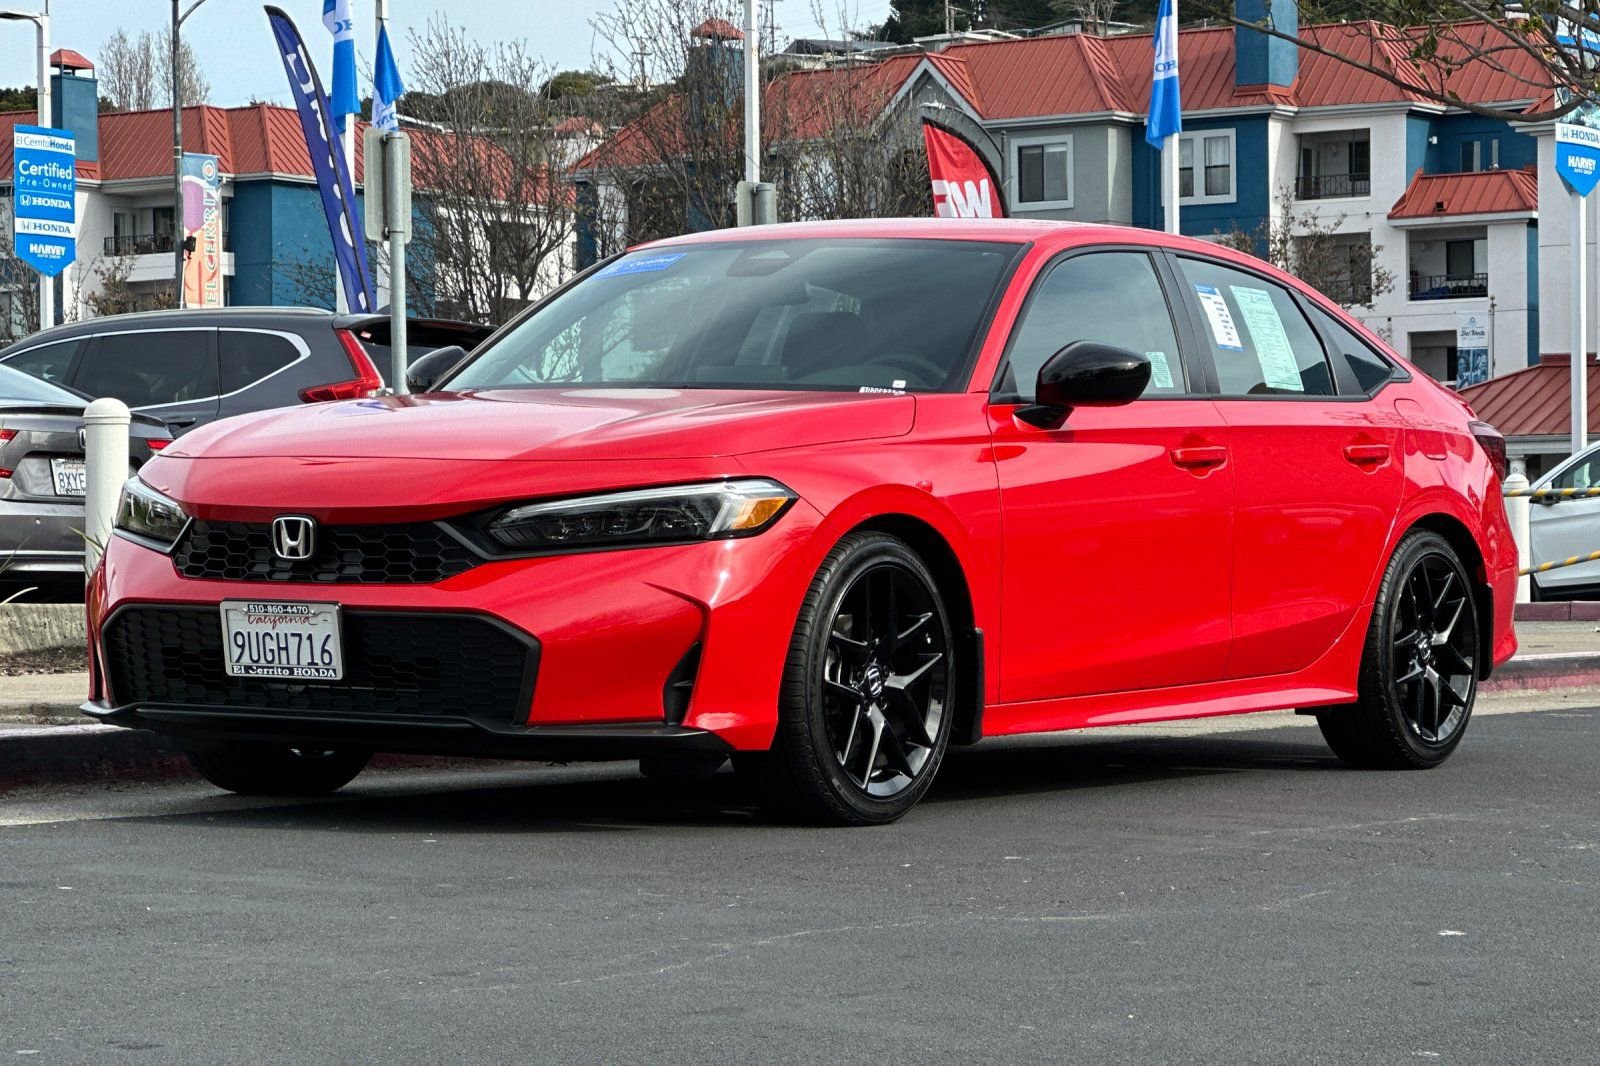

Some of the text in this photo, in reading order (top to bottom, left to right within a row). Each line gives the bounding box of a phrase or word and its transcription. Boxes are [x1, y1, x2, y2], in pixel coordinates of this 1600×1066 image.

[1571, 129, 1600, 144] HONDA
[18, 159, 73, 180] Certified
[1568, 155, 1596, 171] HARVEY
[20, 176, 73, 191] Pre-Owned
[32, 196, 72, 210] HONDA
[33, 222, 71, 234] HONDA
[30, 243, 66, 257] HARVEY
[249, 604, 308, 614] 510-860-4470
[247, 614, 310, 630] California
[233, 630, 333, 666] 9UGH716
[232, 666, 336, 678] El Cerrito HONDA
